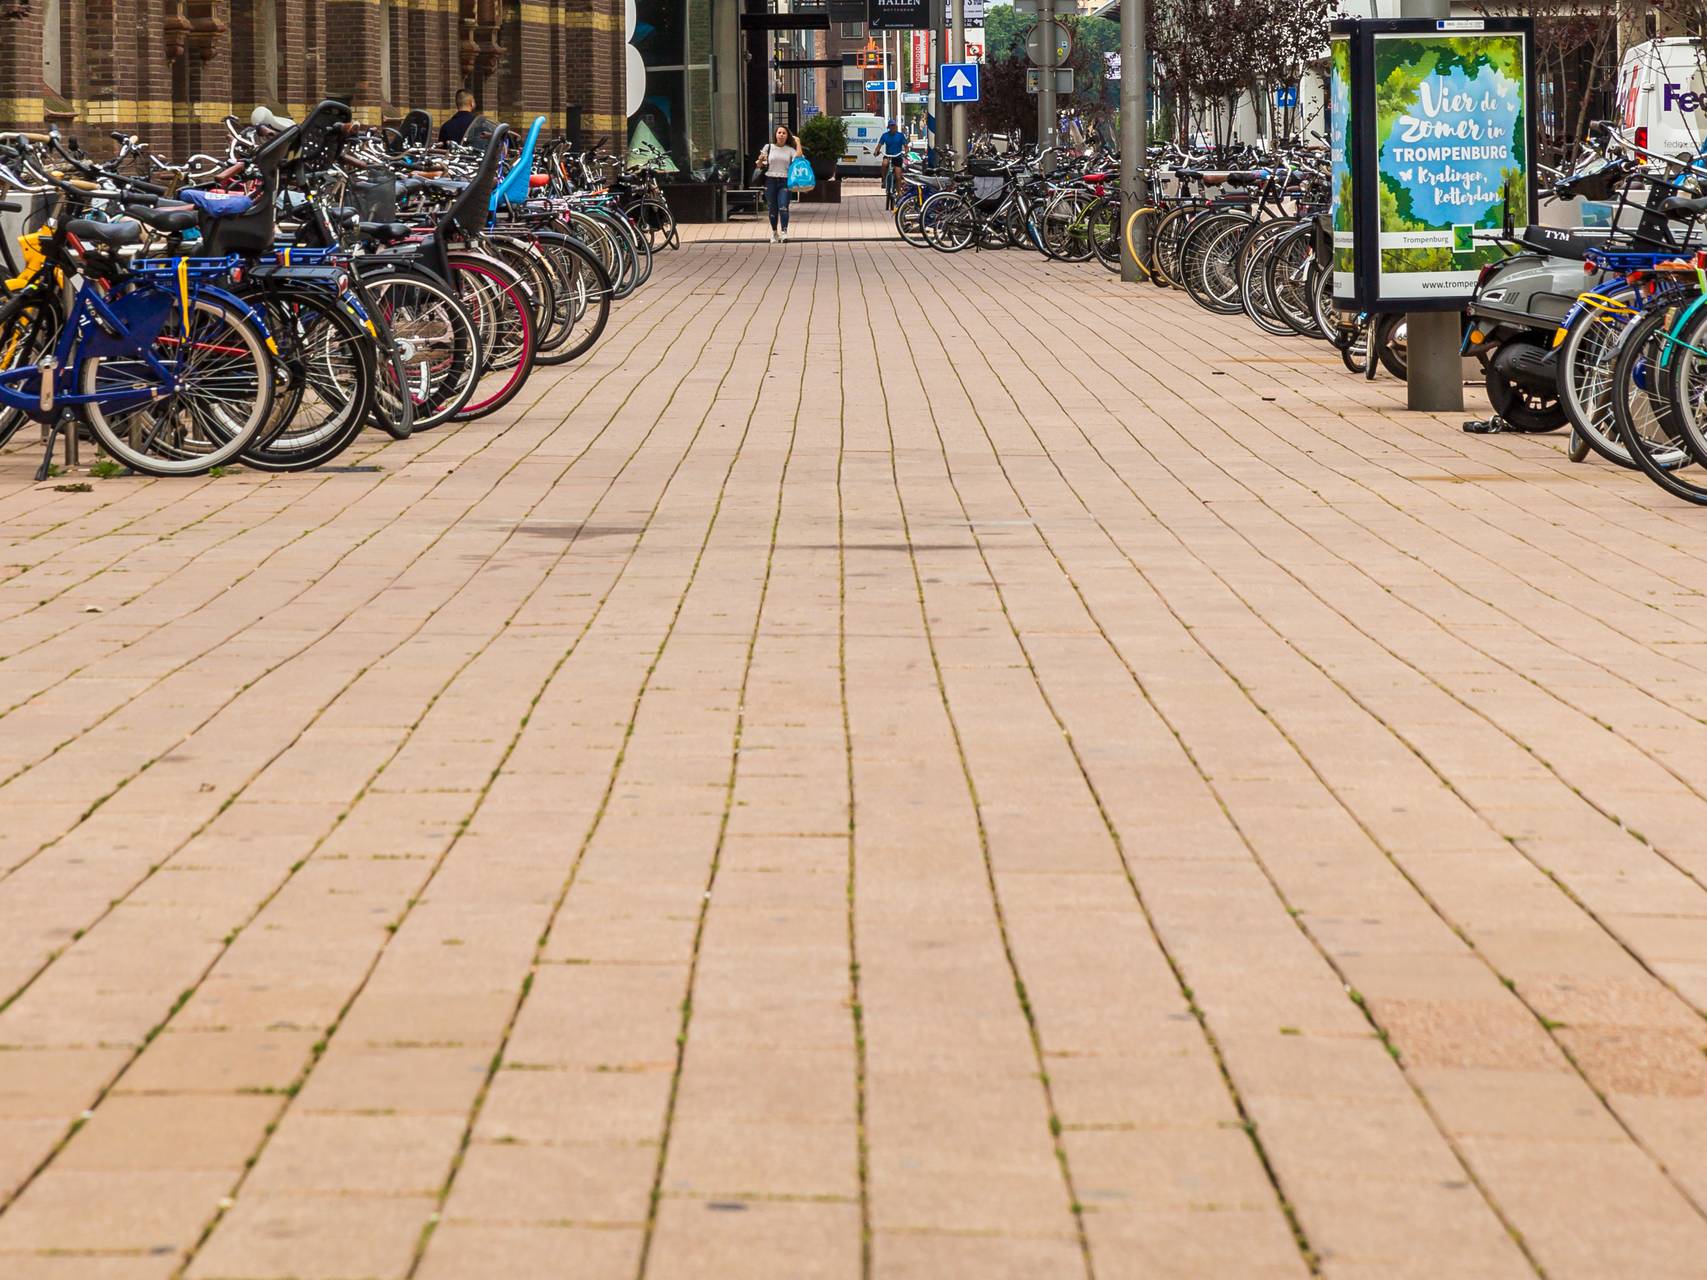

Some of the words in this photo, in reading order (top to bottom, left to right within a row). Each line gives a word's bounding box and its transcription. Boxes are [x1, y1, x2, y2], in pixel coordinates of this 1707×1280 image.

[1420, 75, 1476, 118] Vier
[1481, 90, 1498, 113] de
[1399, 115, 1485, 143] Zomer
[1487, 120, 1506, 140] in
[1393, 145, 1507, 163] TROMPENBURG
[1403, 236, 1449, 246] Trompenburg
[1422, 278, 1478, 291] www.trompen
